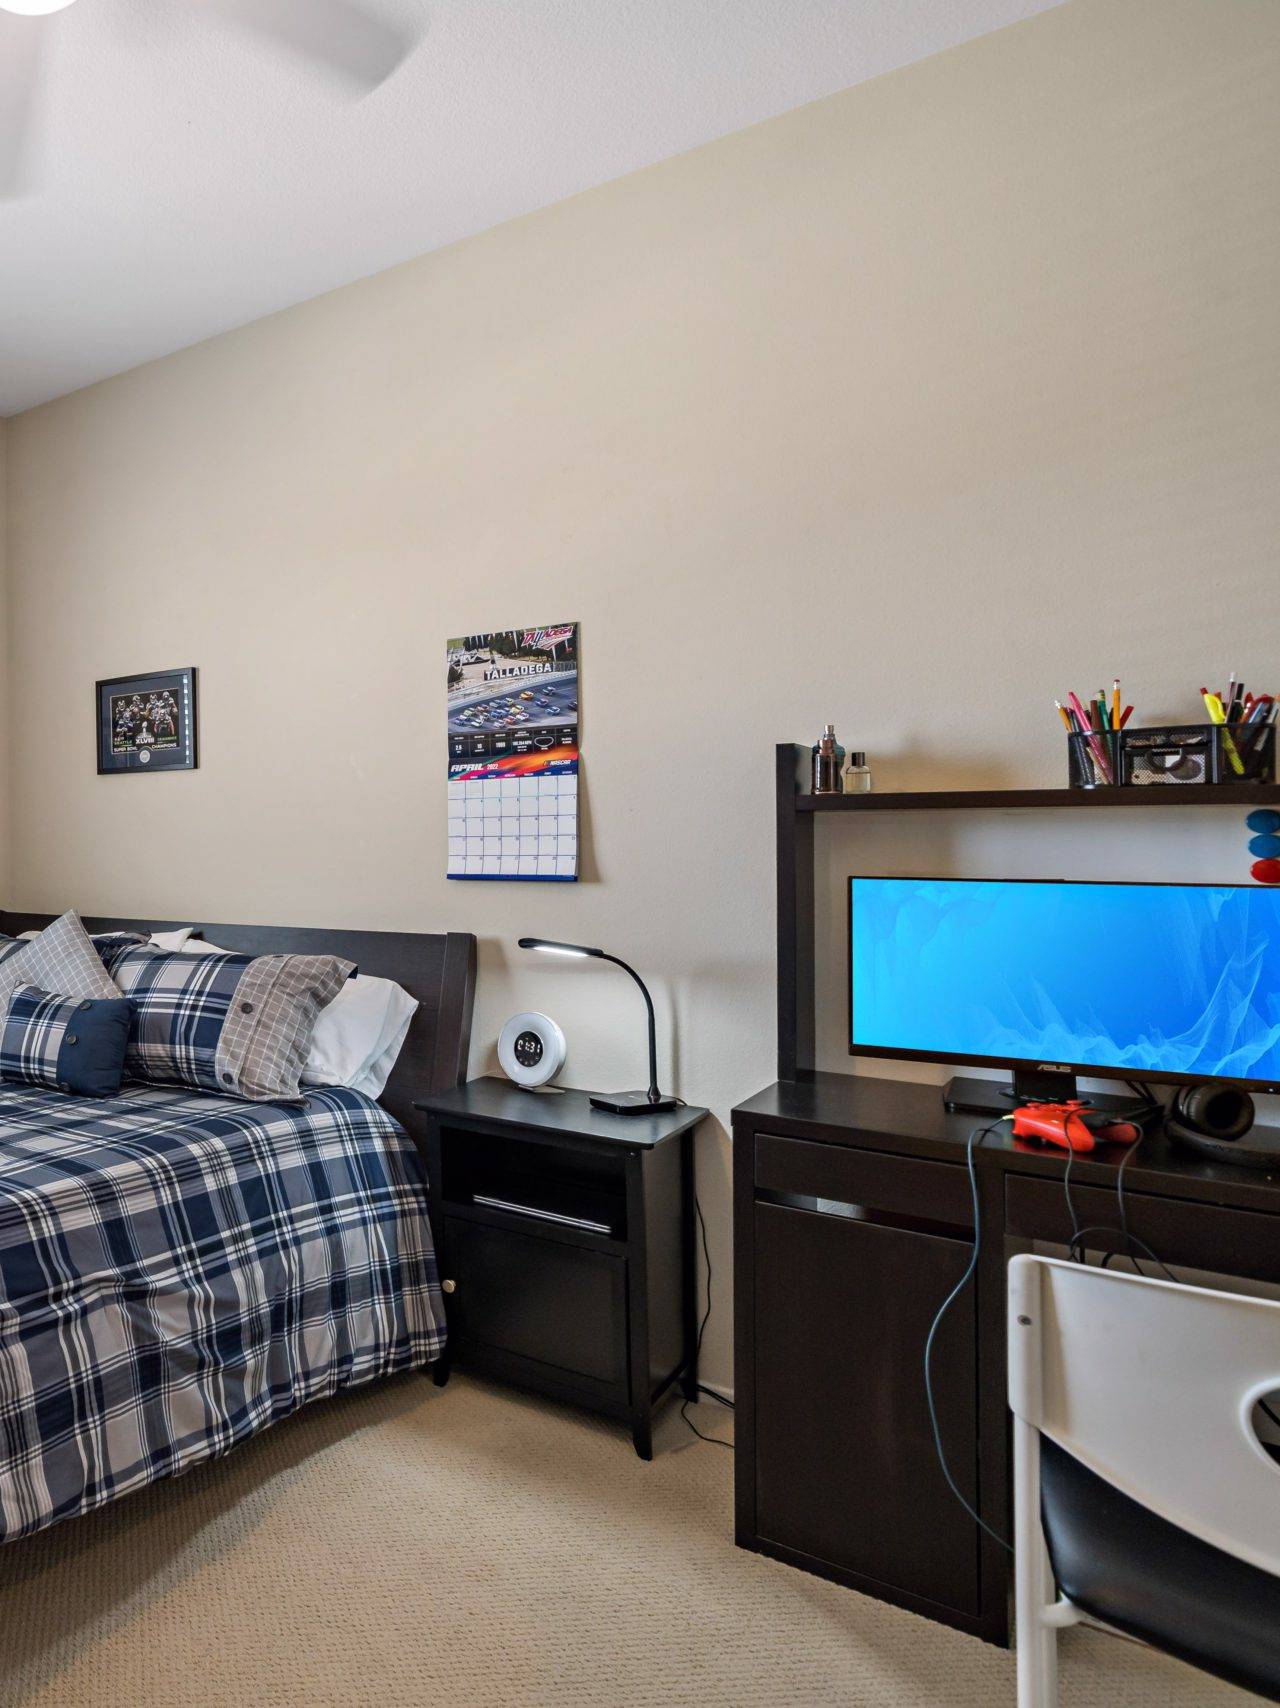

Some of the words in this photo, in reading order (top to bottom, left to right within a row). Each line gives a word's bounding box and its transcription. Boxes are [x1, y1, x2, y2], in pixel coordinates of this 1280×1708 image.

[485, 663, 552, 680] TALLADEGA
[451, 763, 484, 772] APRIL
[1036, 1064, 1072, 1073] ASUS
